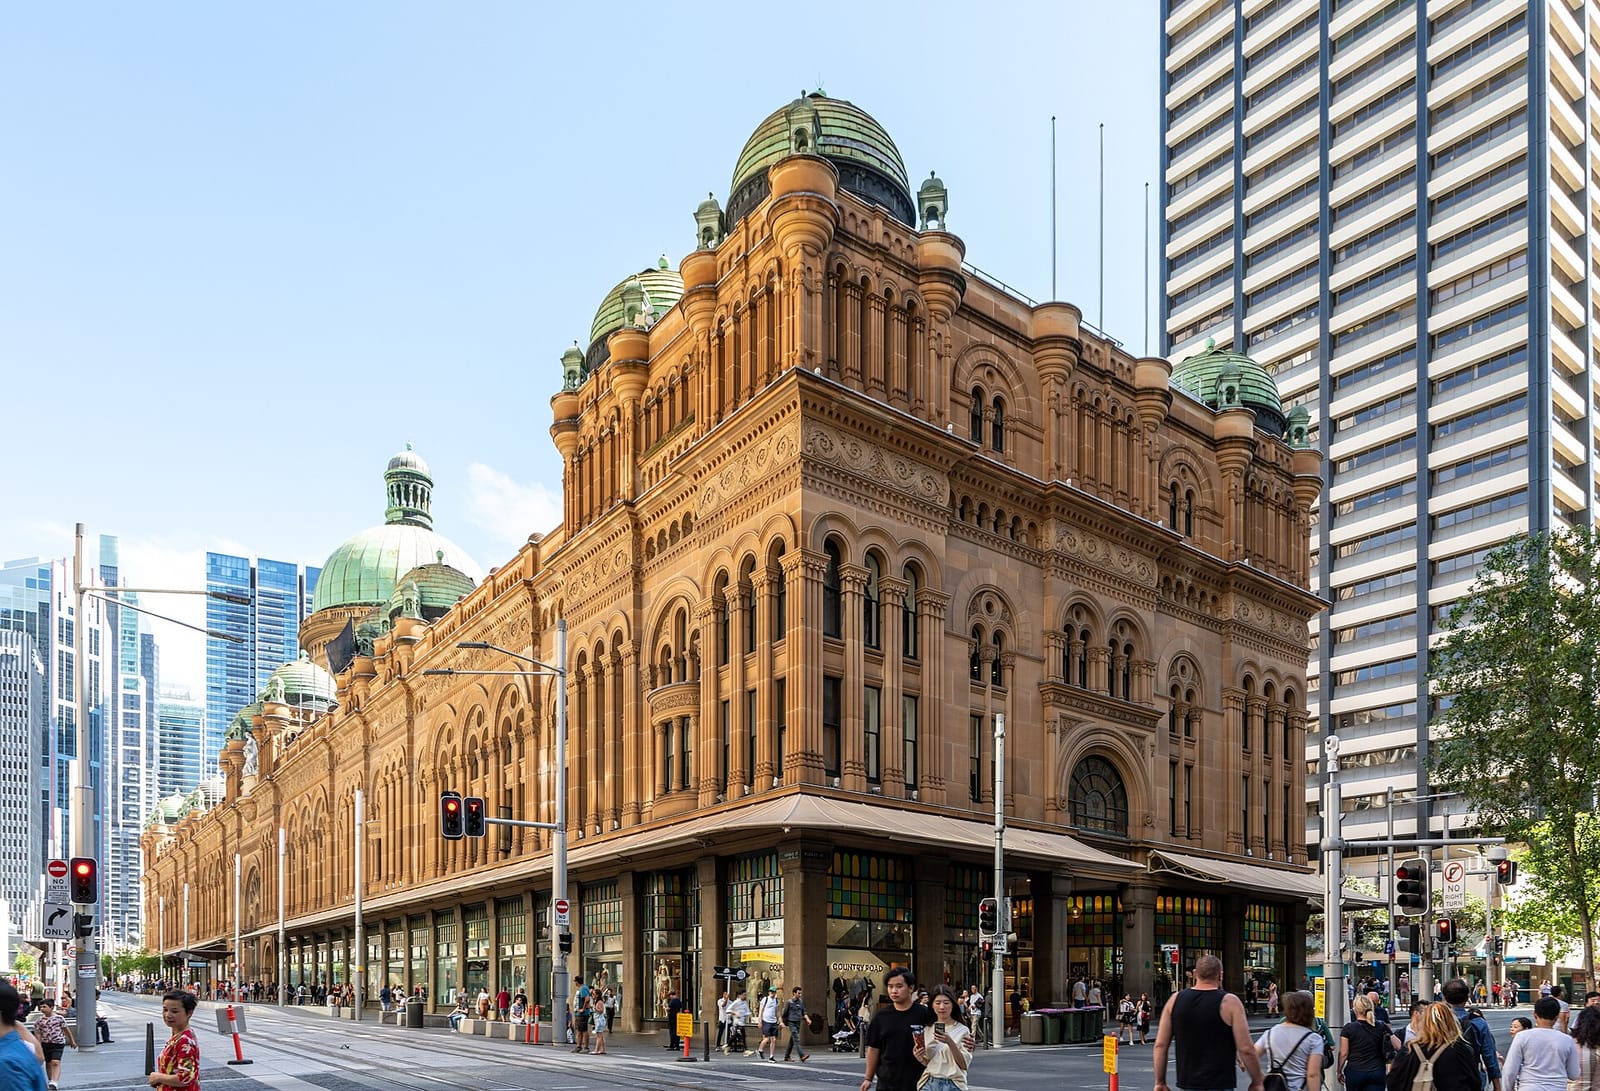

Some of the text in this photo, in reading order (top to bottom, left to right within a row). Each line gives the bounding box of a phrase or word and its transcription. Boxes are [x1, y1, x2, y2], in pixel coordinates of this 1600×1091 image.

[1447, 884, 1460, 892] NO
[45, 928, 70, 936] ONLY
[832, 962, 865, 972] COUNTRY
